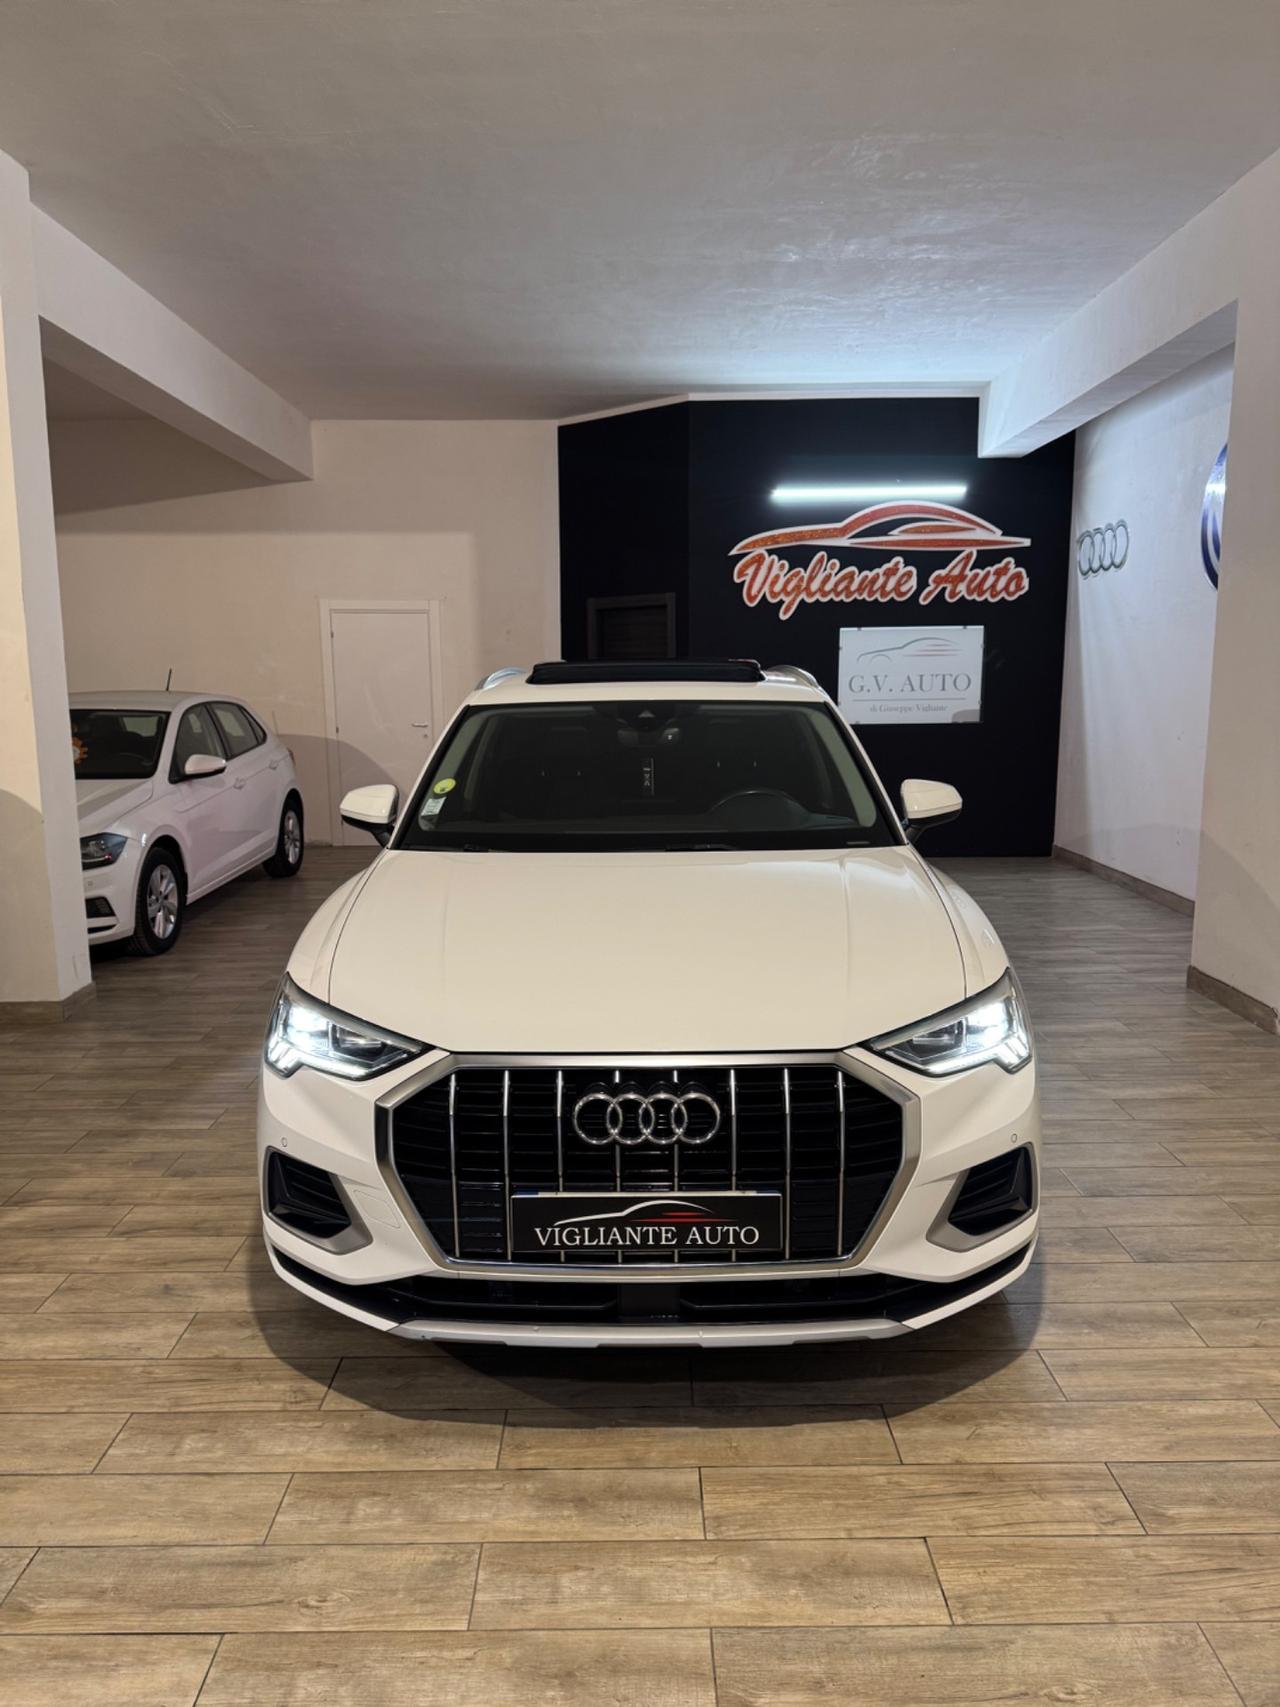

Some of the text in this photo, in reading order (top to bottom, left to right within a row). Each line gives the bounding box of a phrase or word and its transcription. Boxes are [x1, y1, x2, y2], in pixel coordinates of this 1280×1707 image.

[734, 549, 1029, 620] Vigliante Auto
[848, 672, 972, 694] G.V. AUTO
[879, 704, 913, 714] Giuseppe
[916, 703, 948, 713] Vigliante
[534, 1226, 760, 1247] VIGLIANTE AUTO
